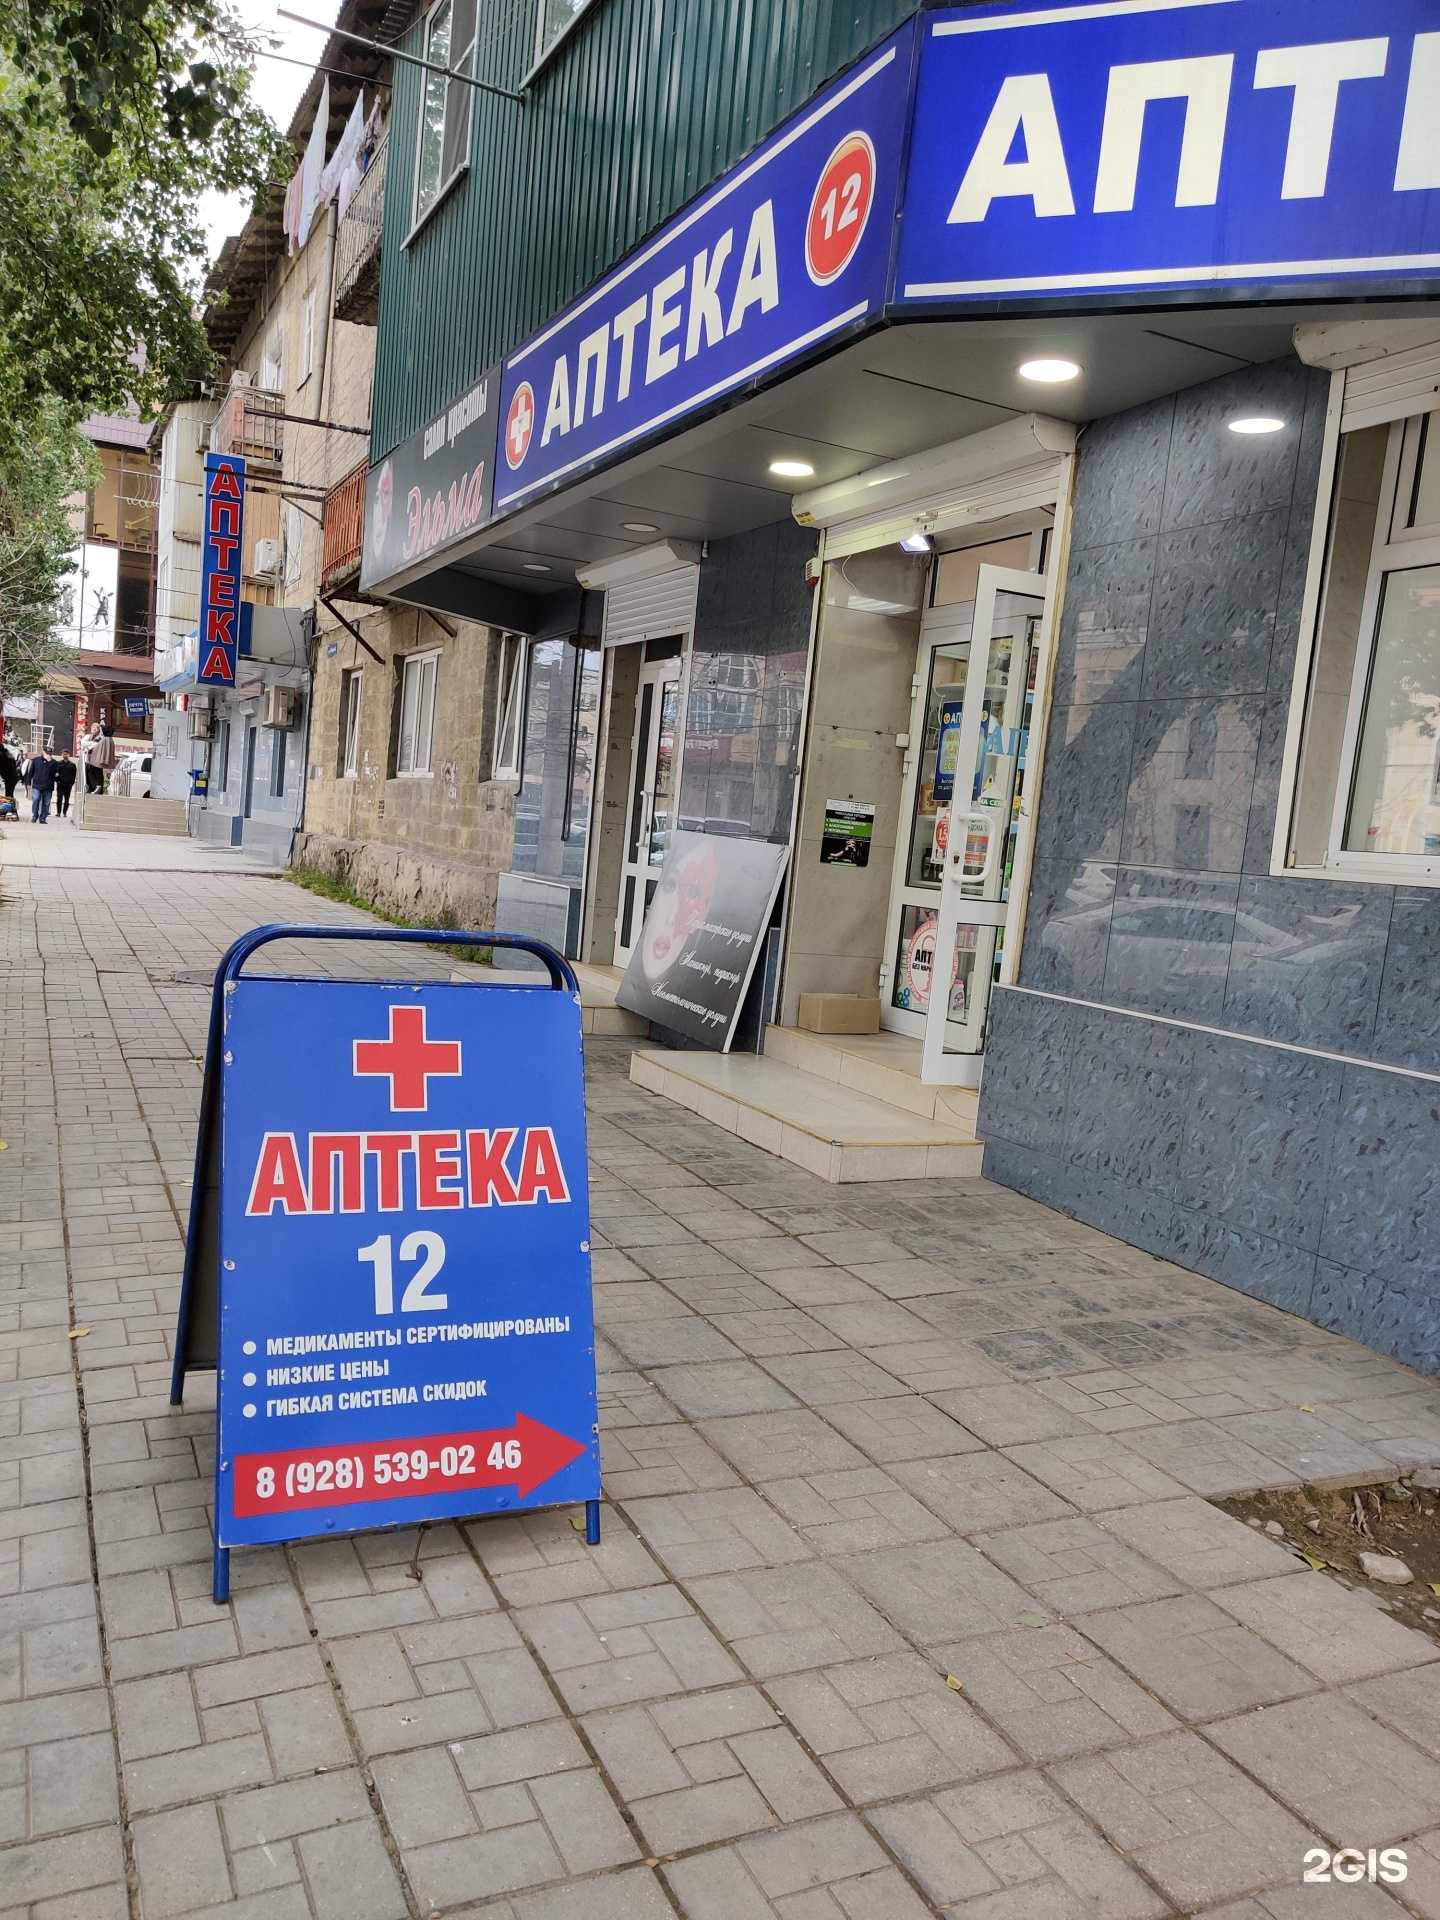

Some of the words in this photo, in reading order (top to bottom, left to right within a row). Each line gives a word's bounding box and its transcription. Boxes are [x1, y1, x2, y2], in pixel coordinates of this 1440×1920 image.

[540, 199, 778, 448] АПТЕКА
[821, 172, 862, 240] 12
[201, 463, 242, 681] АПТЕКА
[245, 1126, 571, 1217] АПТЕКА
[357, 1230, 448, 1315] 12
[266, 1329, 401, 1356] МЕДИКАМЕНТЫ
[406, 1316, 570, 1345] СЕРТИФИЦИРОВАНЫ
[266, 1364, 335, 1387] НИЗКИЕ
[340, 1360, 389, 1382] ЦЕНЫ
[266, 1395, 333, 1418] ГИБКАЯ
[338, 1387, 418, 1411] СИСТЕМА
[423, 1380, 487, 1403] СКИДОК
[256, 1467, 275, 1499] 8
[285, 1456, 364, 1497] (928)
[374, 1445, 476, 1485] 539-02
[487, 1439, 522, 1471] 46
